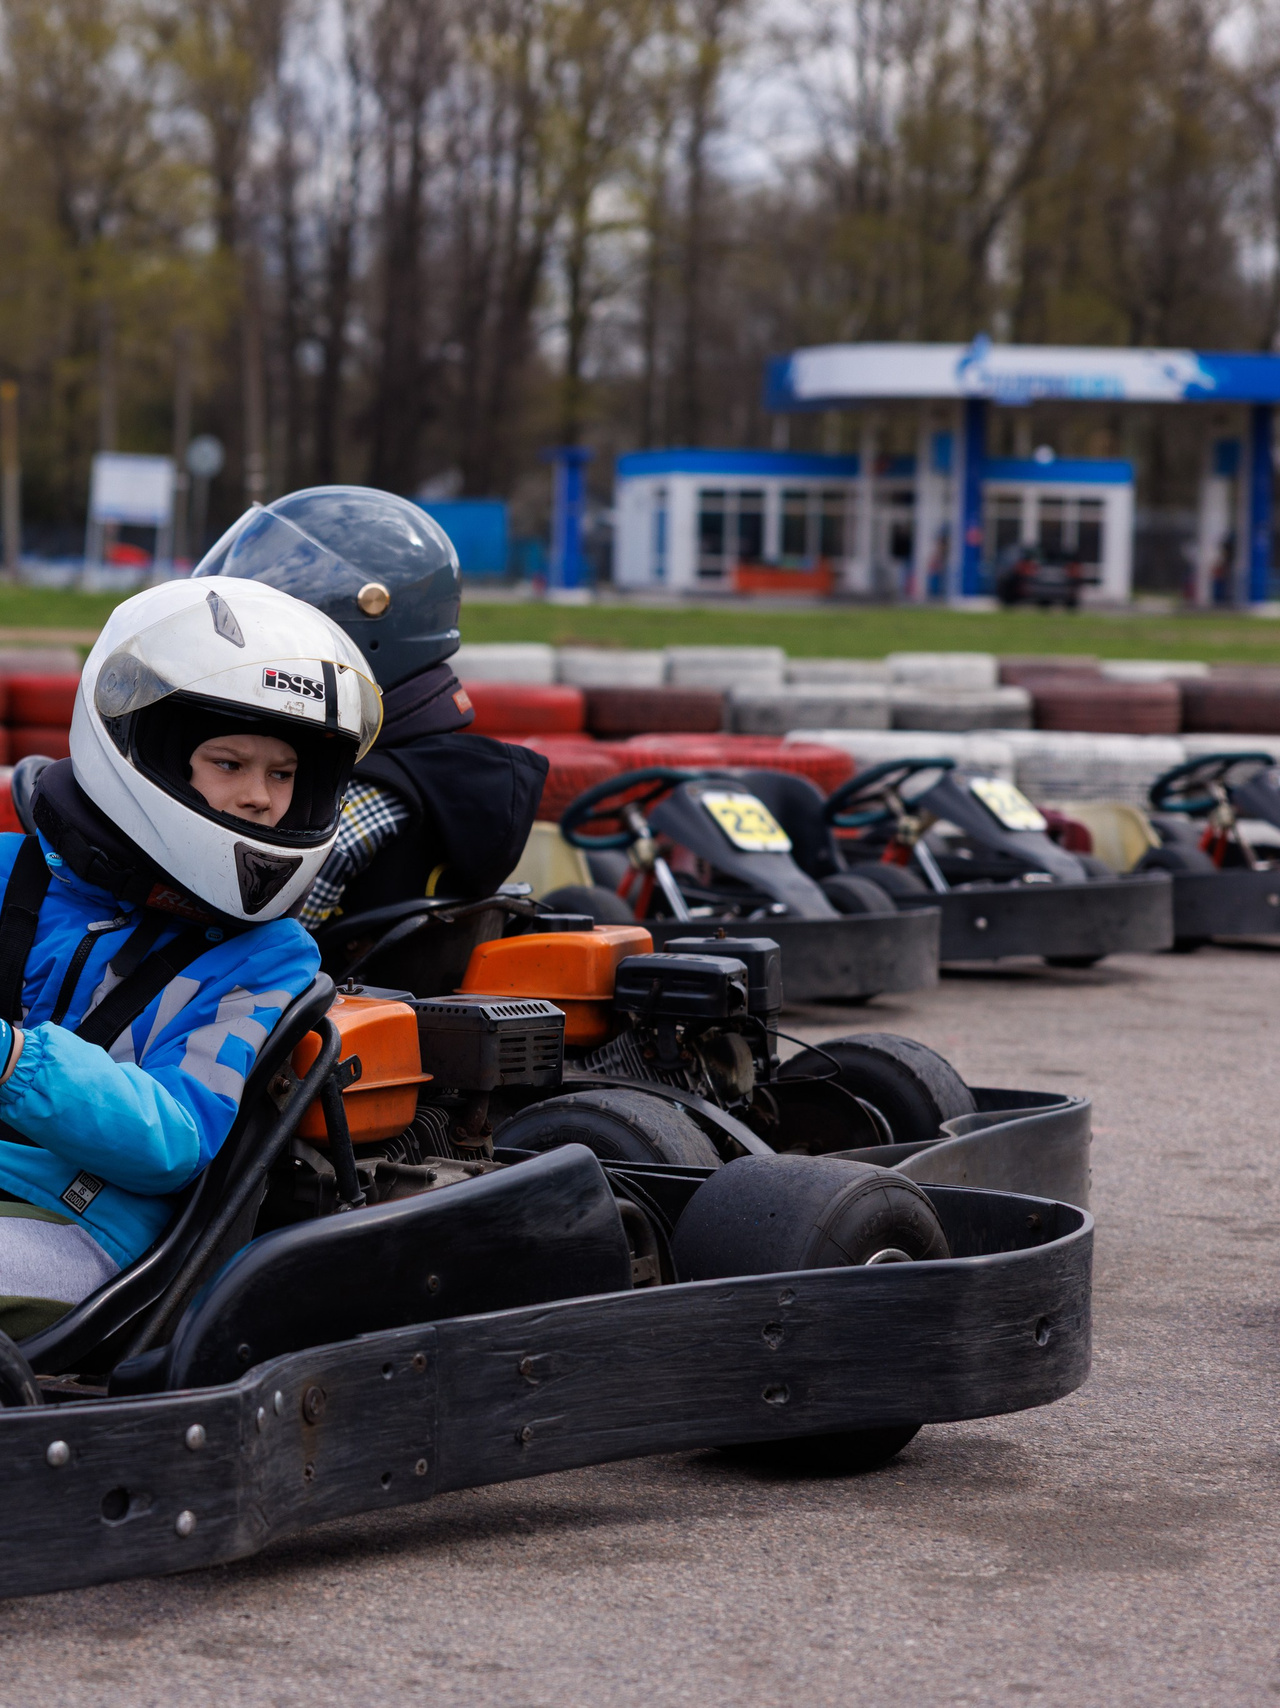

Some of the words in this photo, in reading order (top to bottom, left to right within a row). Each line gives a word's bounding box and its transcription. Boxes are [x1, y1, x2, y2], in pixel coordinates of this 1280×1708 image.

[720, 808, 777, 836] 23
[81, 1175, 98, 1192] GOOD
[67, 1191, 84, 1207] GOOD
